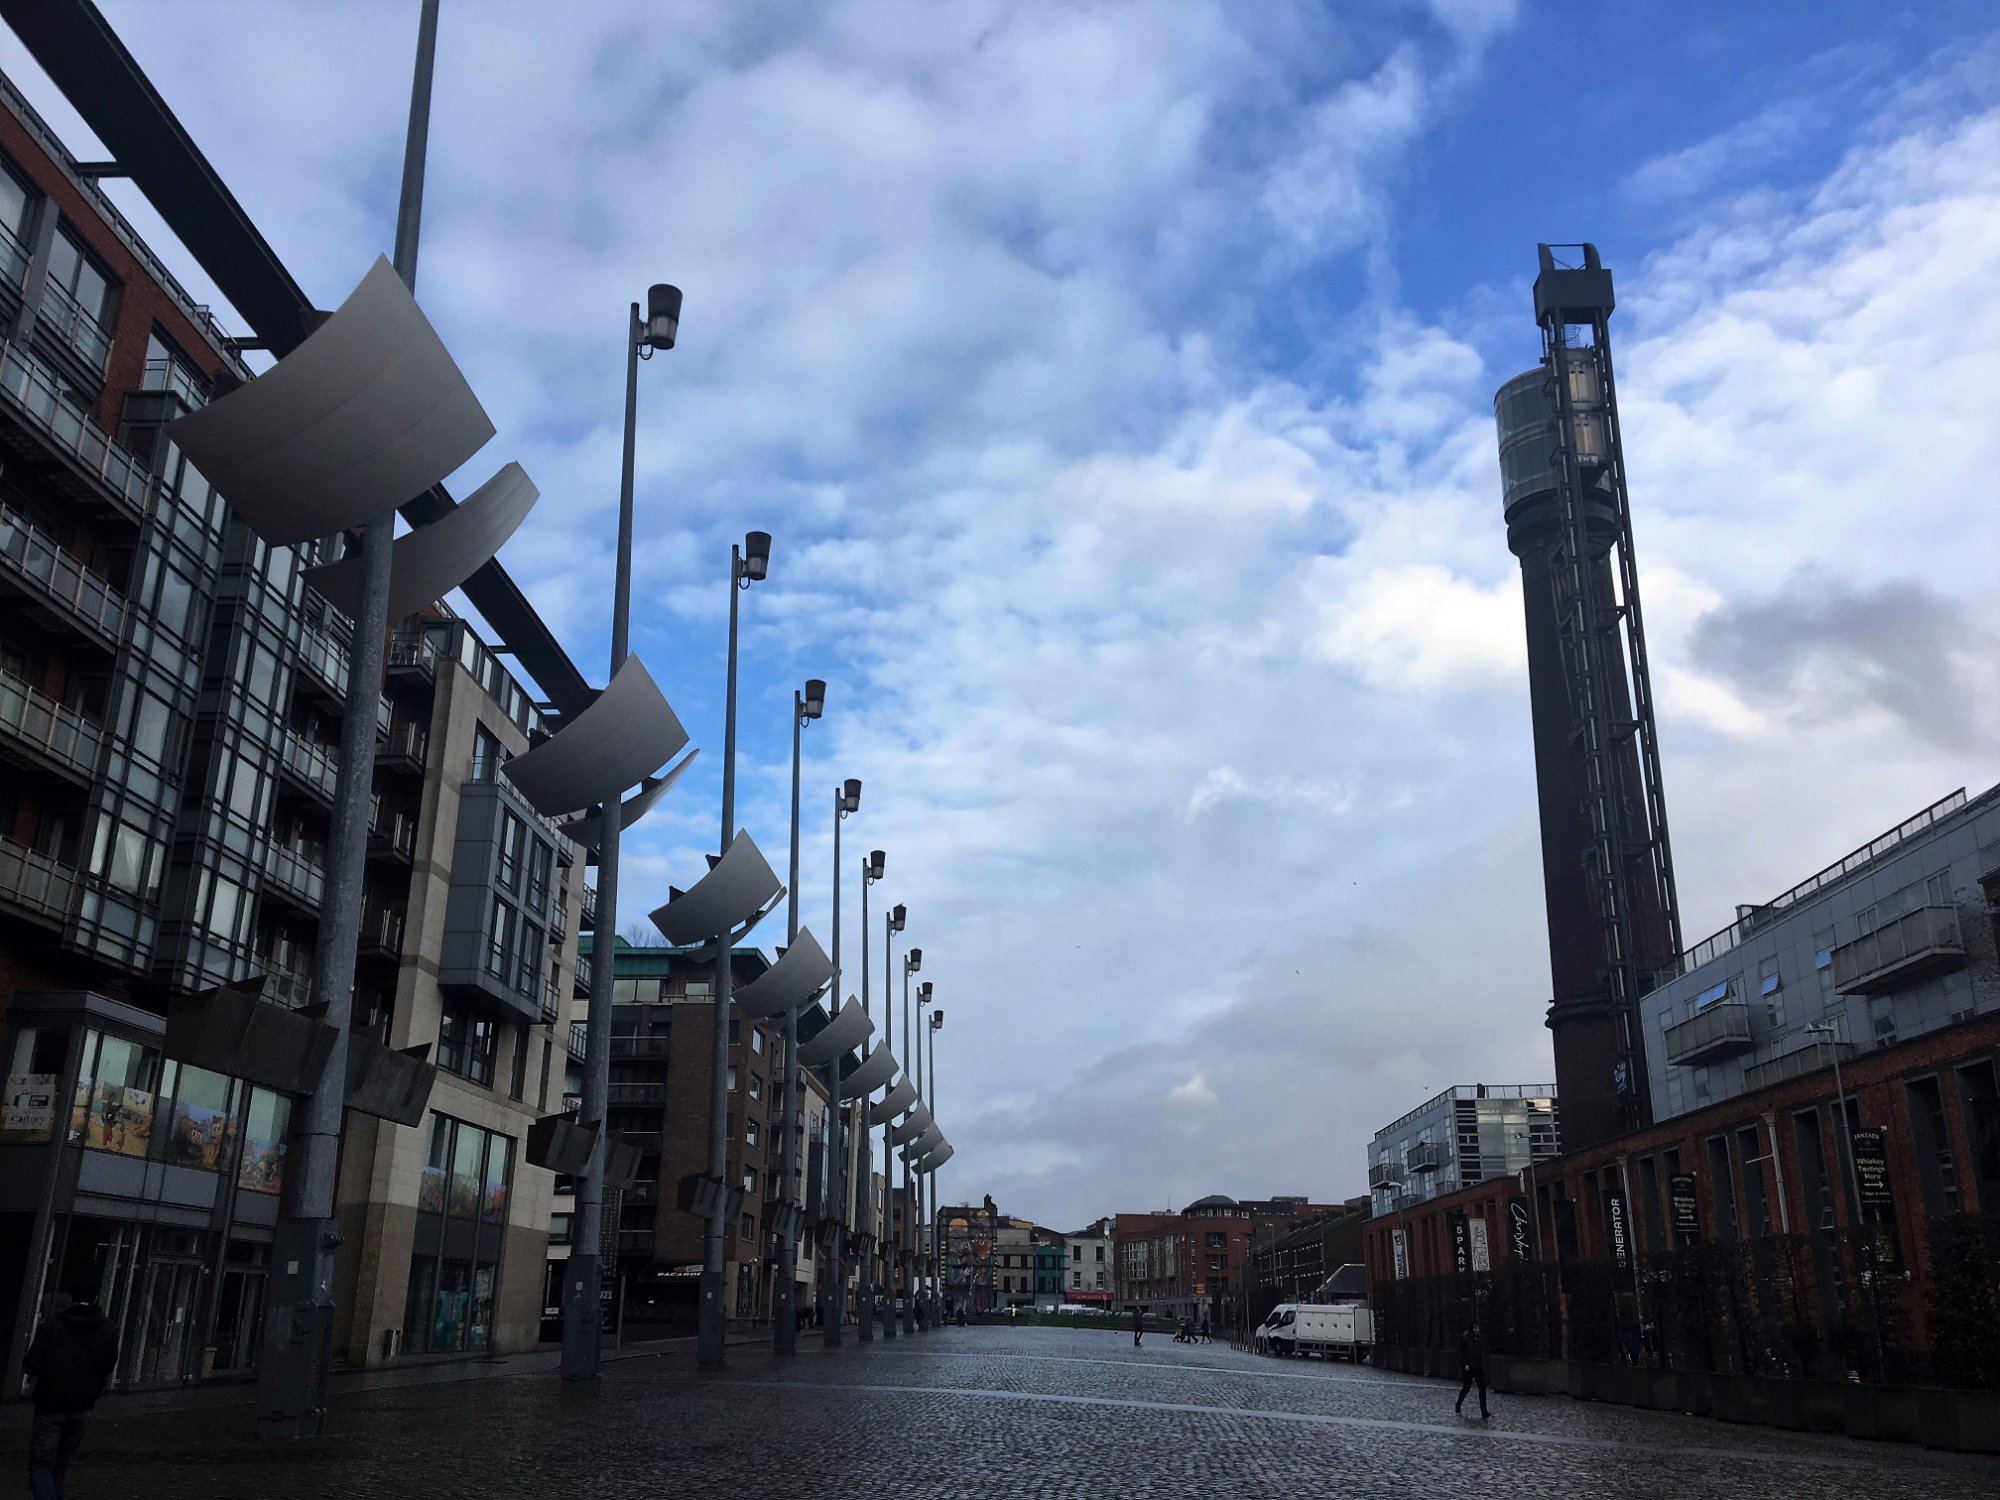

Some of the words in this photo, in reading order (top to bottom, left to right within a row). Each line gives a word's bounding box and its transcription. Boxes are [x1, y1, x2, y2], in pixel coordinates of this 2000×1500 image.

[1854, 1132, 1880, 1140] JAMESON
[1856, 1158, 1885, 1166] Whiskey
[1611, 1198, 1627, 1268] GENERATOR
